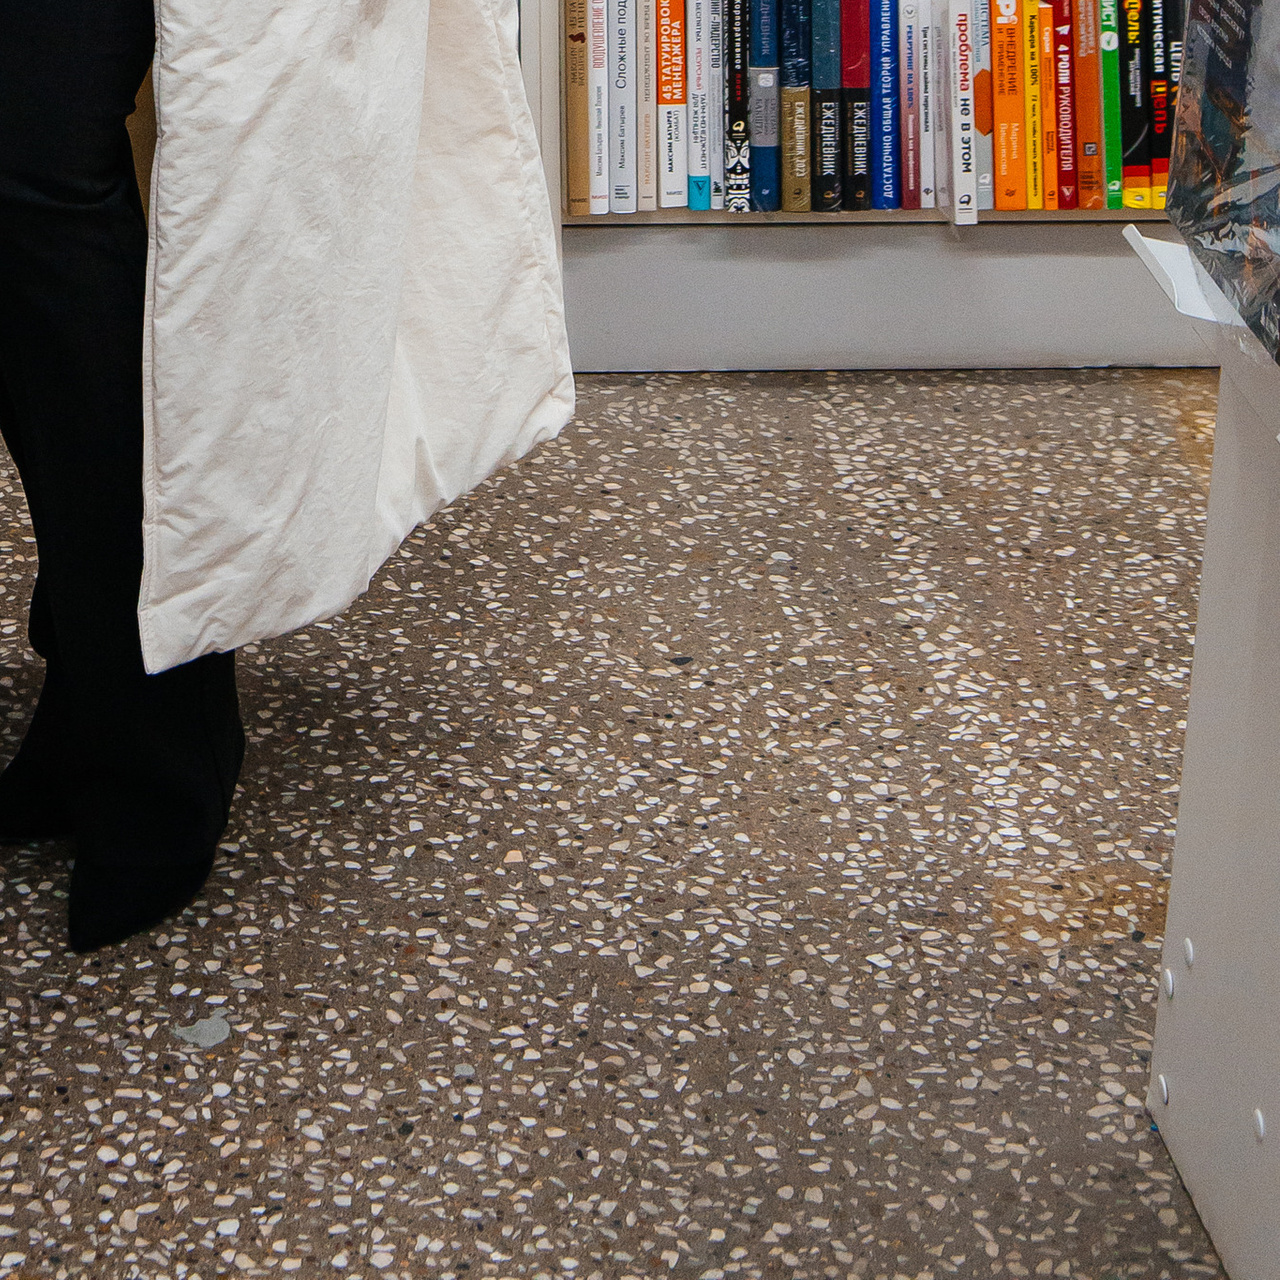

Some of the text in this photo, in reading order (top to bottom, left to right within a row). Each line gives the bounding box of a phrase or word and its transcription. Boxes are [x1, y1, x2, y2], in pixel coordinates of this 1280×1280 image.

[615, 28, 627, 89] Сложные
[671, 21, 682, 99] МЕНЕДЖЕРА
[956, 13, 971, 173] проблема не в этом
[1057, 54, 1071, 84] РОЛИ
[822, 102, 835, 175] ЕЖЕДНЕВНИК
[854, 102, 867, 175] ЕЖЕДНЕВНИК
[1058, 86, 1073, 171] РУКОВОДИТЕЛЯ
